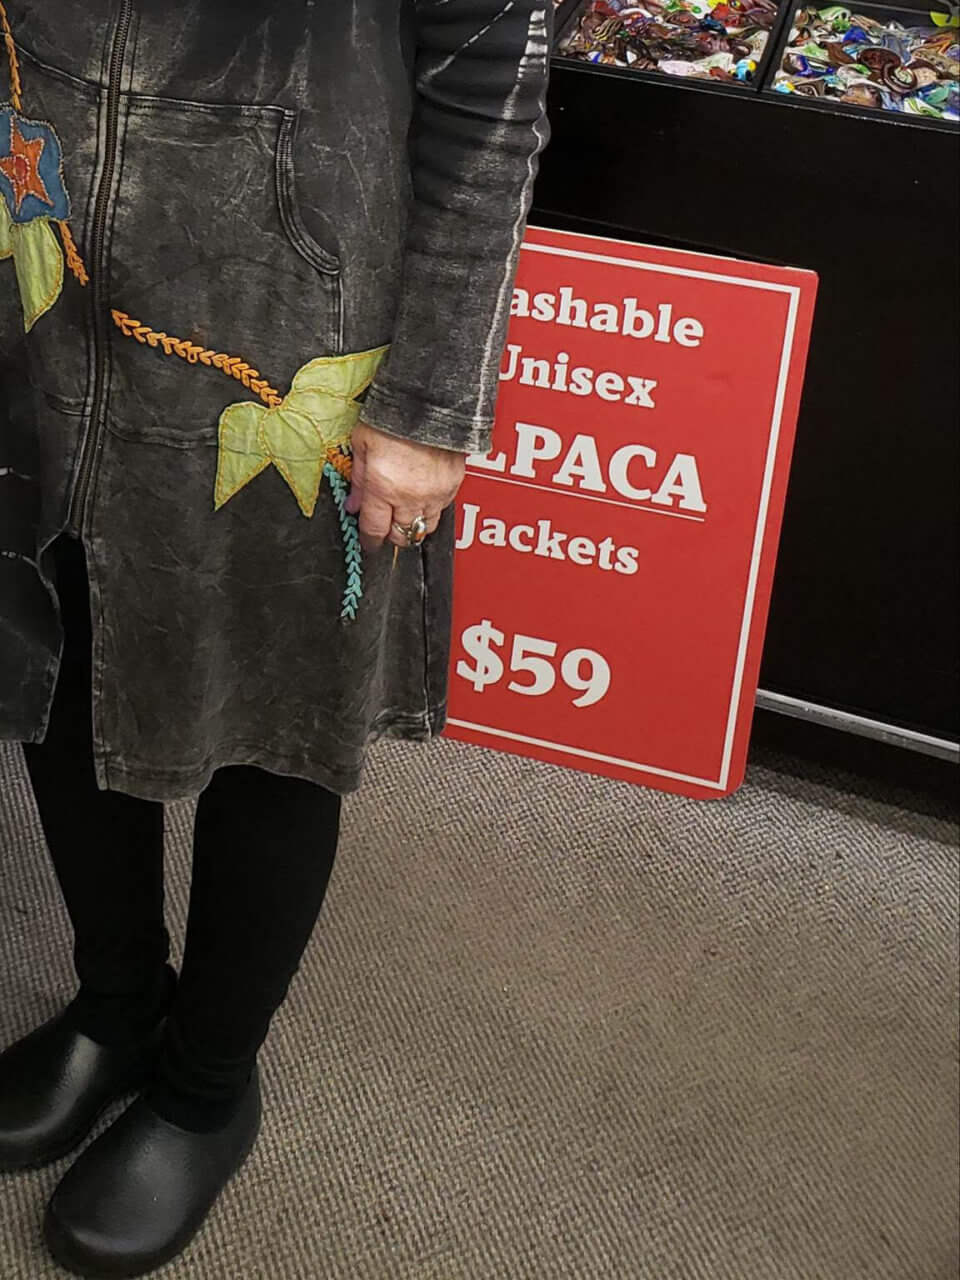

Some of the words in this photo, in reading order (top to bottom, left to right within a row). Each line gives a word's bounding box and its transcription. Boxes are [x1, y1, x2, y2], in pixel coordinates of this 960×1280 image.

[509, 286, 705, 348] ashable
[455, 503, 640, 575] Jackets
[456, 619, 611, 708] $59
